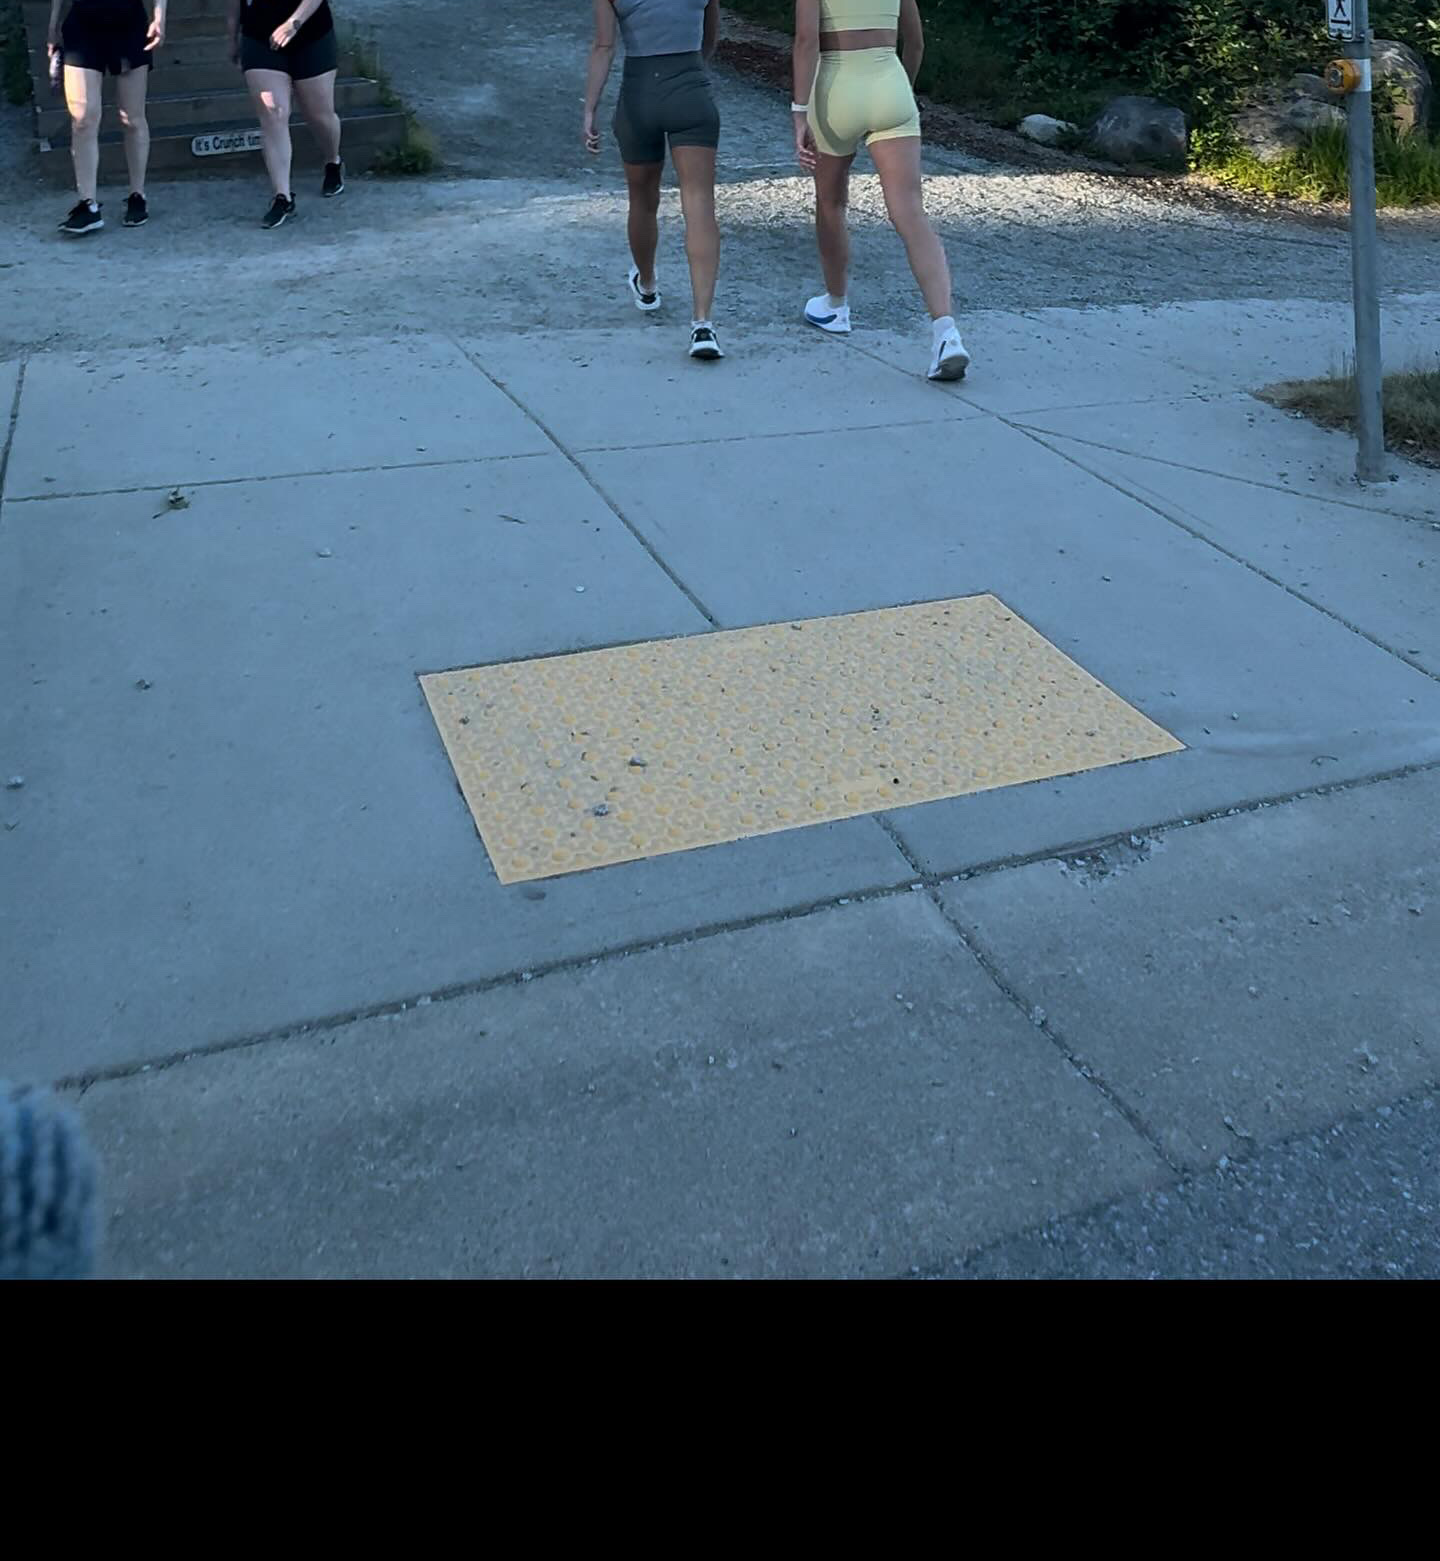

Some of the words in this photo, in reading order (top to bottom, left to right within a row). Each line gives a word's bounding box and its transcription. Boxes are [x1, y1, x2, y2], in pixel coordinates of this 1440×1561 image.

[195, 137, 209, 152] It's
[212, 135, 245, 150] Crunch
[247, 135, 263, 146] tim
